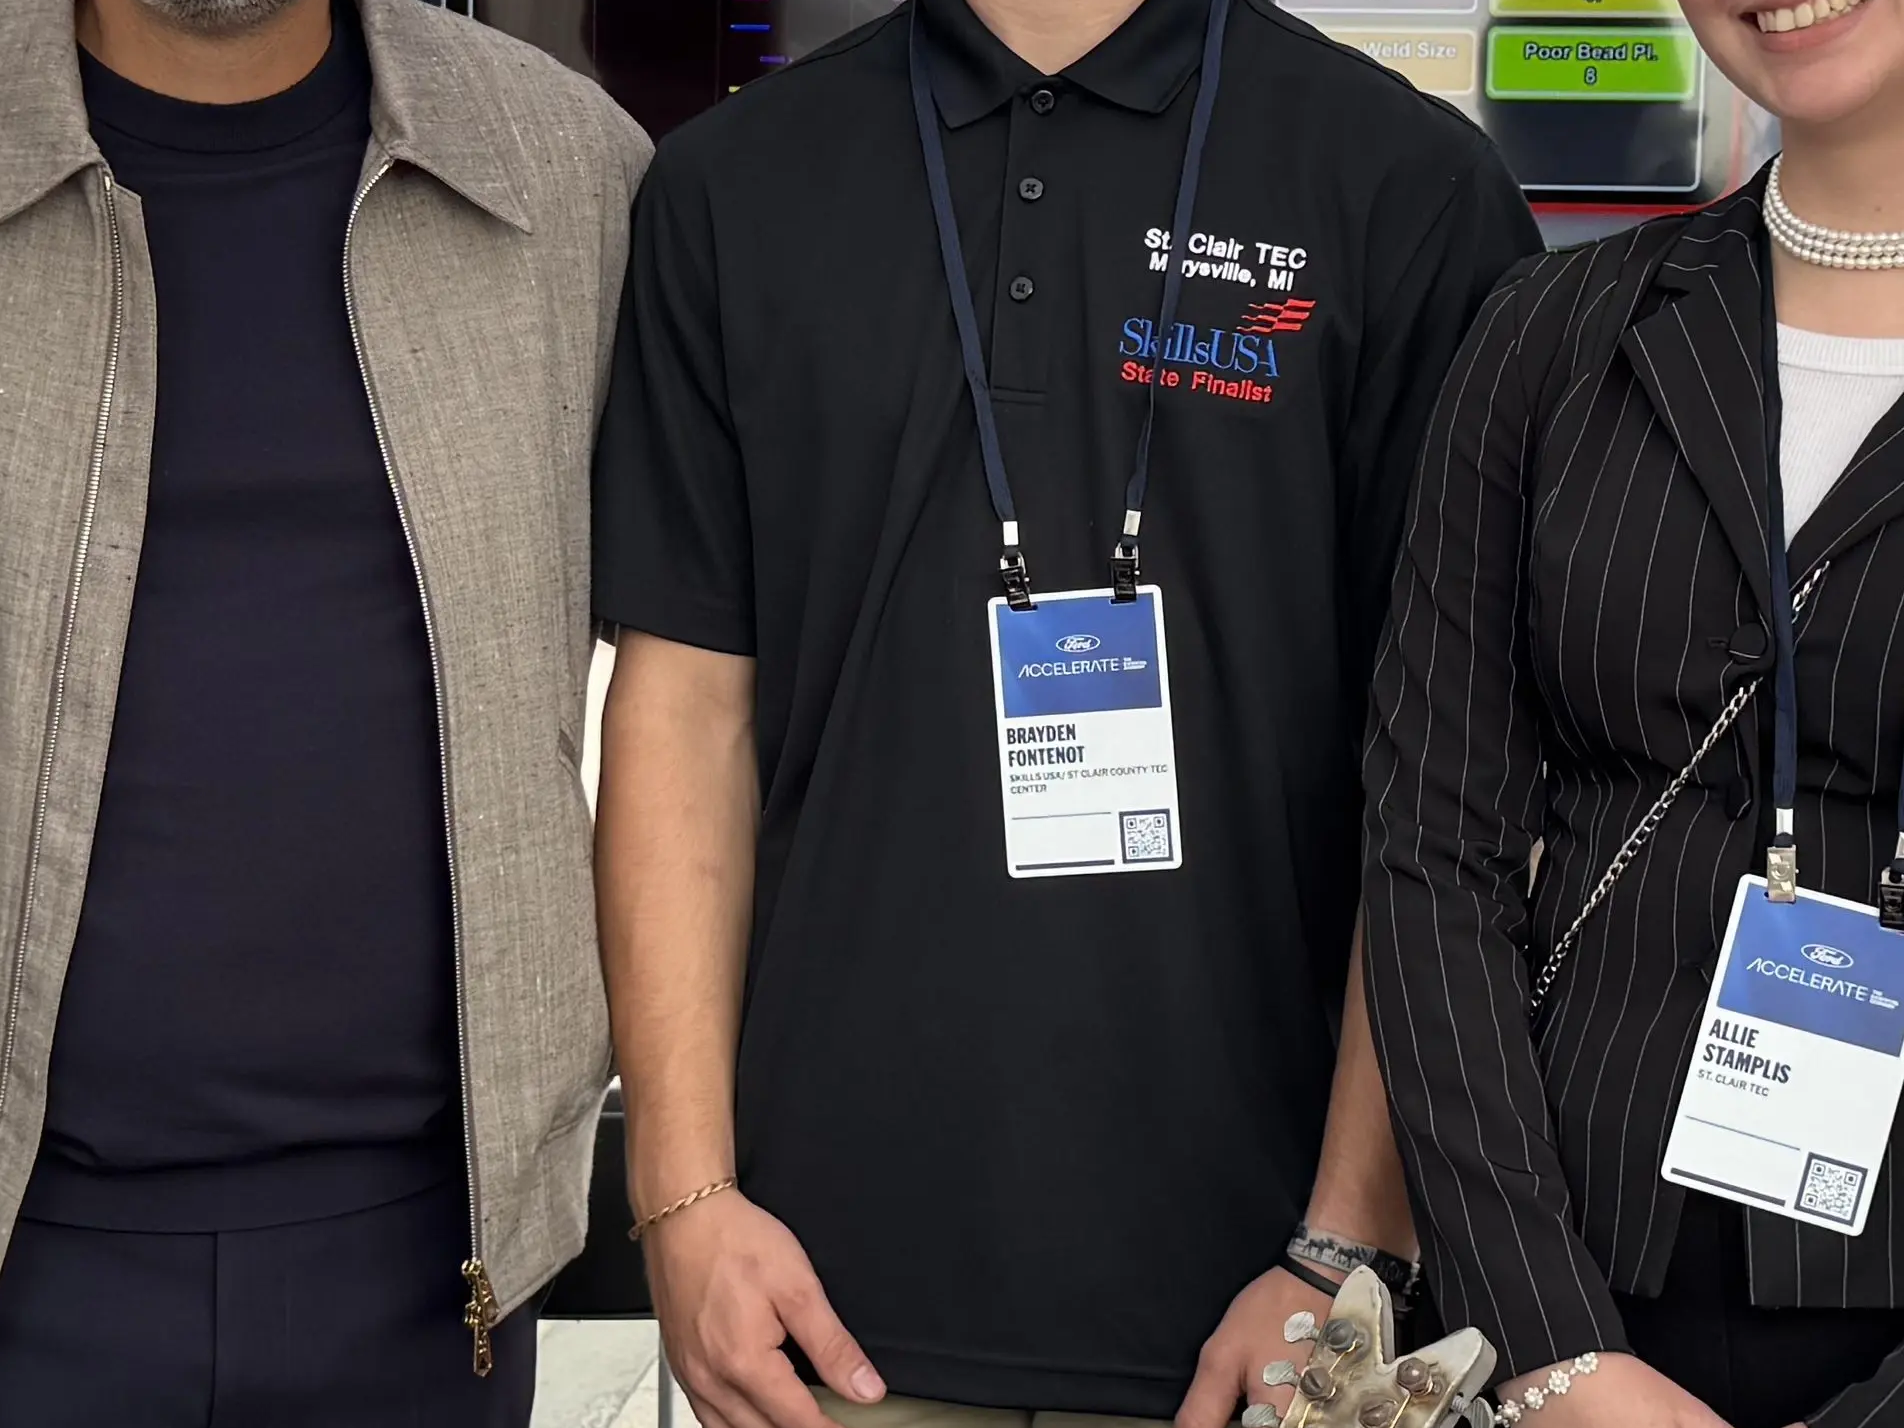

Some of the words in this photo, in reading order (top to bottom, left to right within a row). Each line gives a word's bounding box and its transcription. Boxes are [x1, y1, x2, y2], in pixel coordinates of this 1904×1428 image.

[1364, 42, 1410, 58] Weld
[1417, 42, 1456, 58] Size
[1524, 43, 1572, 61] Poor
[1576, 43, 1628, 61] Bead
[1585, 67, 1596, 84] 8
[1188, 232, 1244, 260] Clair
[1255, 242, 1307, 269] TEC
[1149, 252, 1256, 287] Mrysville,
[1268, 269, 1294, 291] MI
[1119, 317, 1280, 378] SkillsUSA
[1191, 371, 1273, 402] Finalist
[1018, 658, 1120, 679] ACCELERATE
[1006, 723, 1077, 745] BRAYDEN
[1008, 745, 1085, 768] FONTENOT
[1747, 957, 1869, 1002] ACCELERATE
[1708, 1018, 1760, 1049] ALLIE
[1703, 1043, 1792, 1084] STAMPLIS
[1715, 1073, 1747, 1092] CLAIR
[1749, 1084, 1770, 1098] TEC
